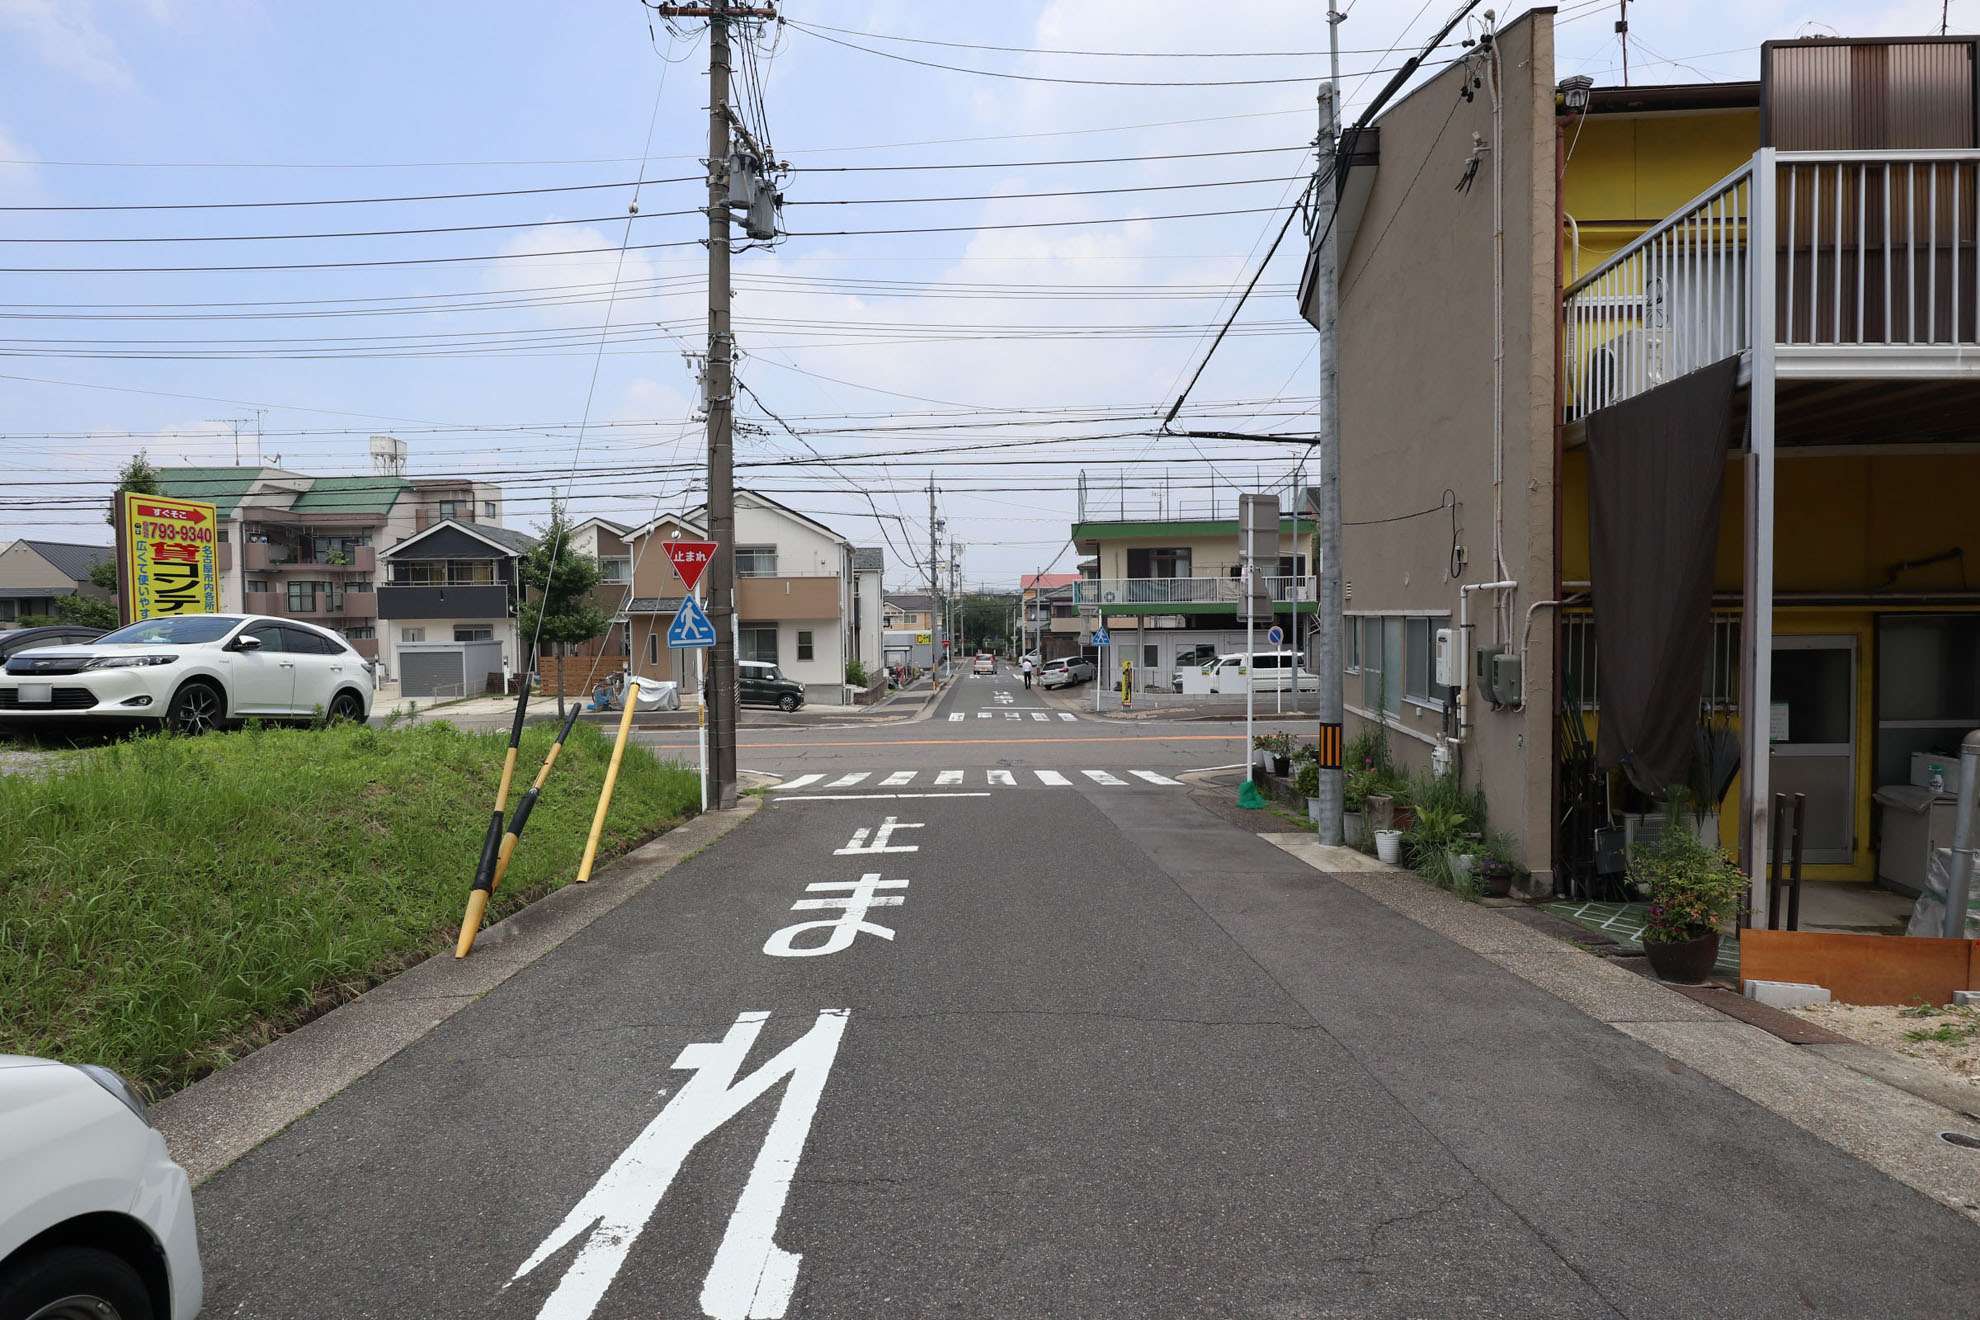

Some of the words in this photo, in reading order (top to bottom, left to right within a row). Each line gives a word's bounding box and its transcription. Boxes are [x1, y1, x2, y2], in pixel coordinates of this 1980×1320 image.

[153, 508, 187, 519] すぐそこ
[149, 522, 212, 543] 793-9340
[674, 551, 707, 562] 止まれ
[149, 542, 201, 614] 貸コンテ
[503, 816, 925, 1320] 止まれ
